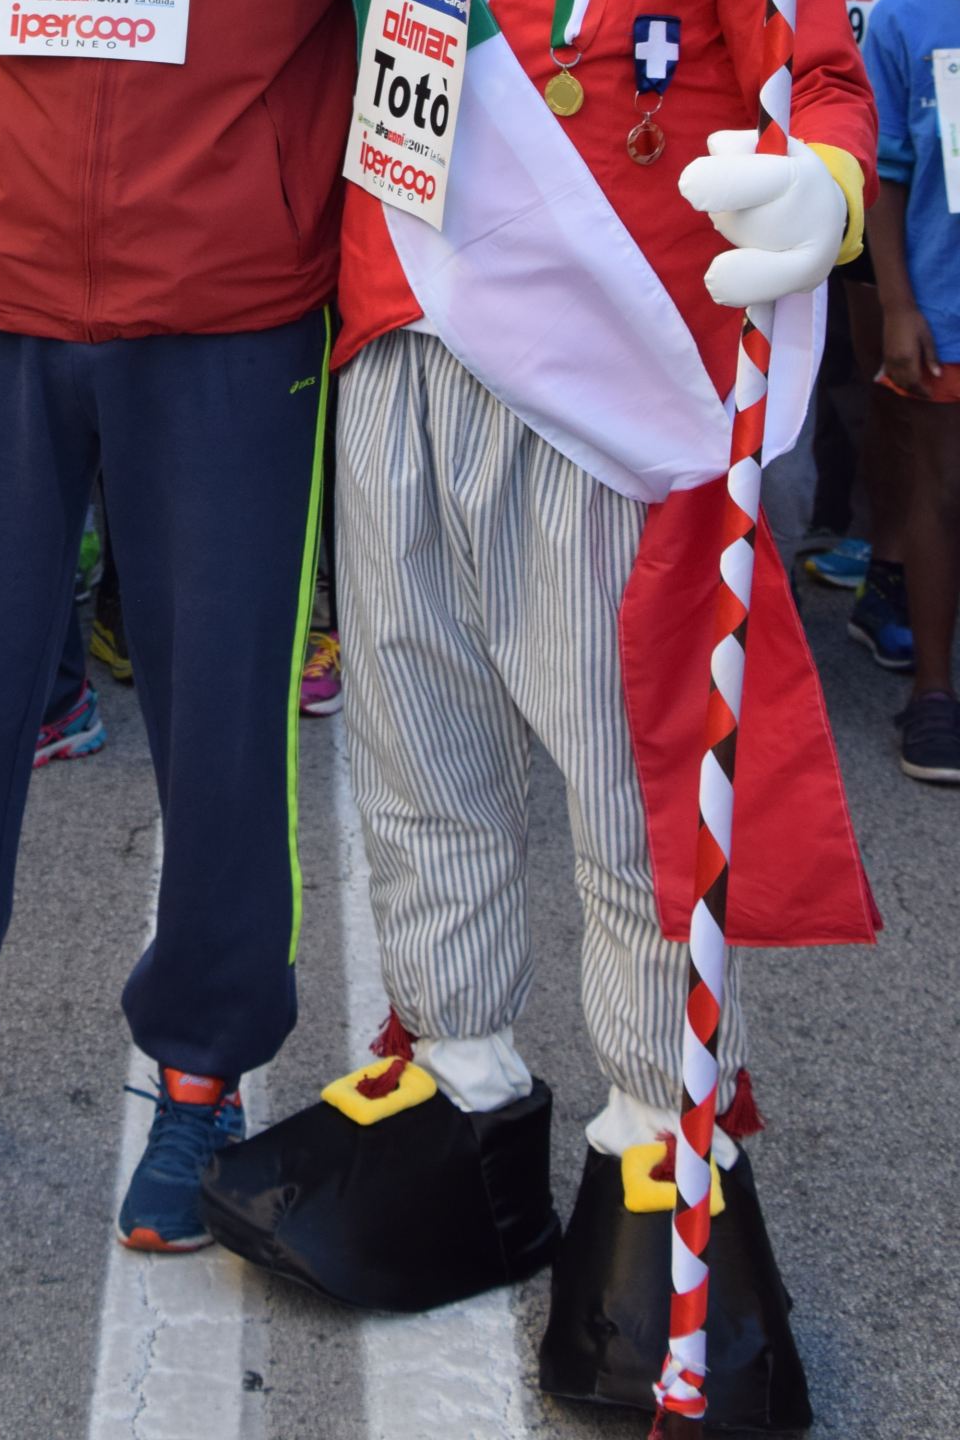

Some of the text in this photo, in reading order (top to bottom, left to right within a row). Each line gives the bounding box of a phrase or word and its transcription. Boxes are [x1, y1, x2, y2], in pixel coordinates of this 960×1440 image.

[10, 3, 155, 48] ipercoop
[45, 39, 116, 49] CUNEO
[382, 2, 458, 68] olimac
[374, 49, 449, 137] Totò
[360, 131, 436, 204] ipercoop
[373, 176, 414, 200] CUNEO
